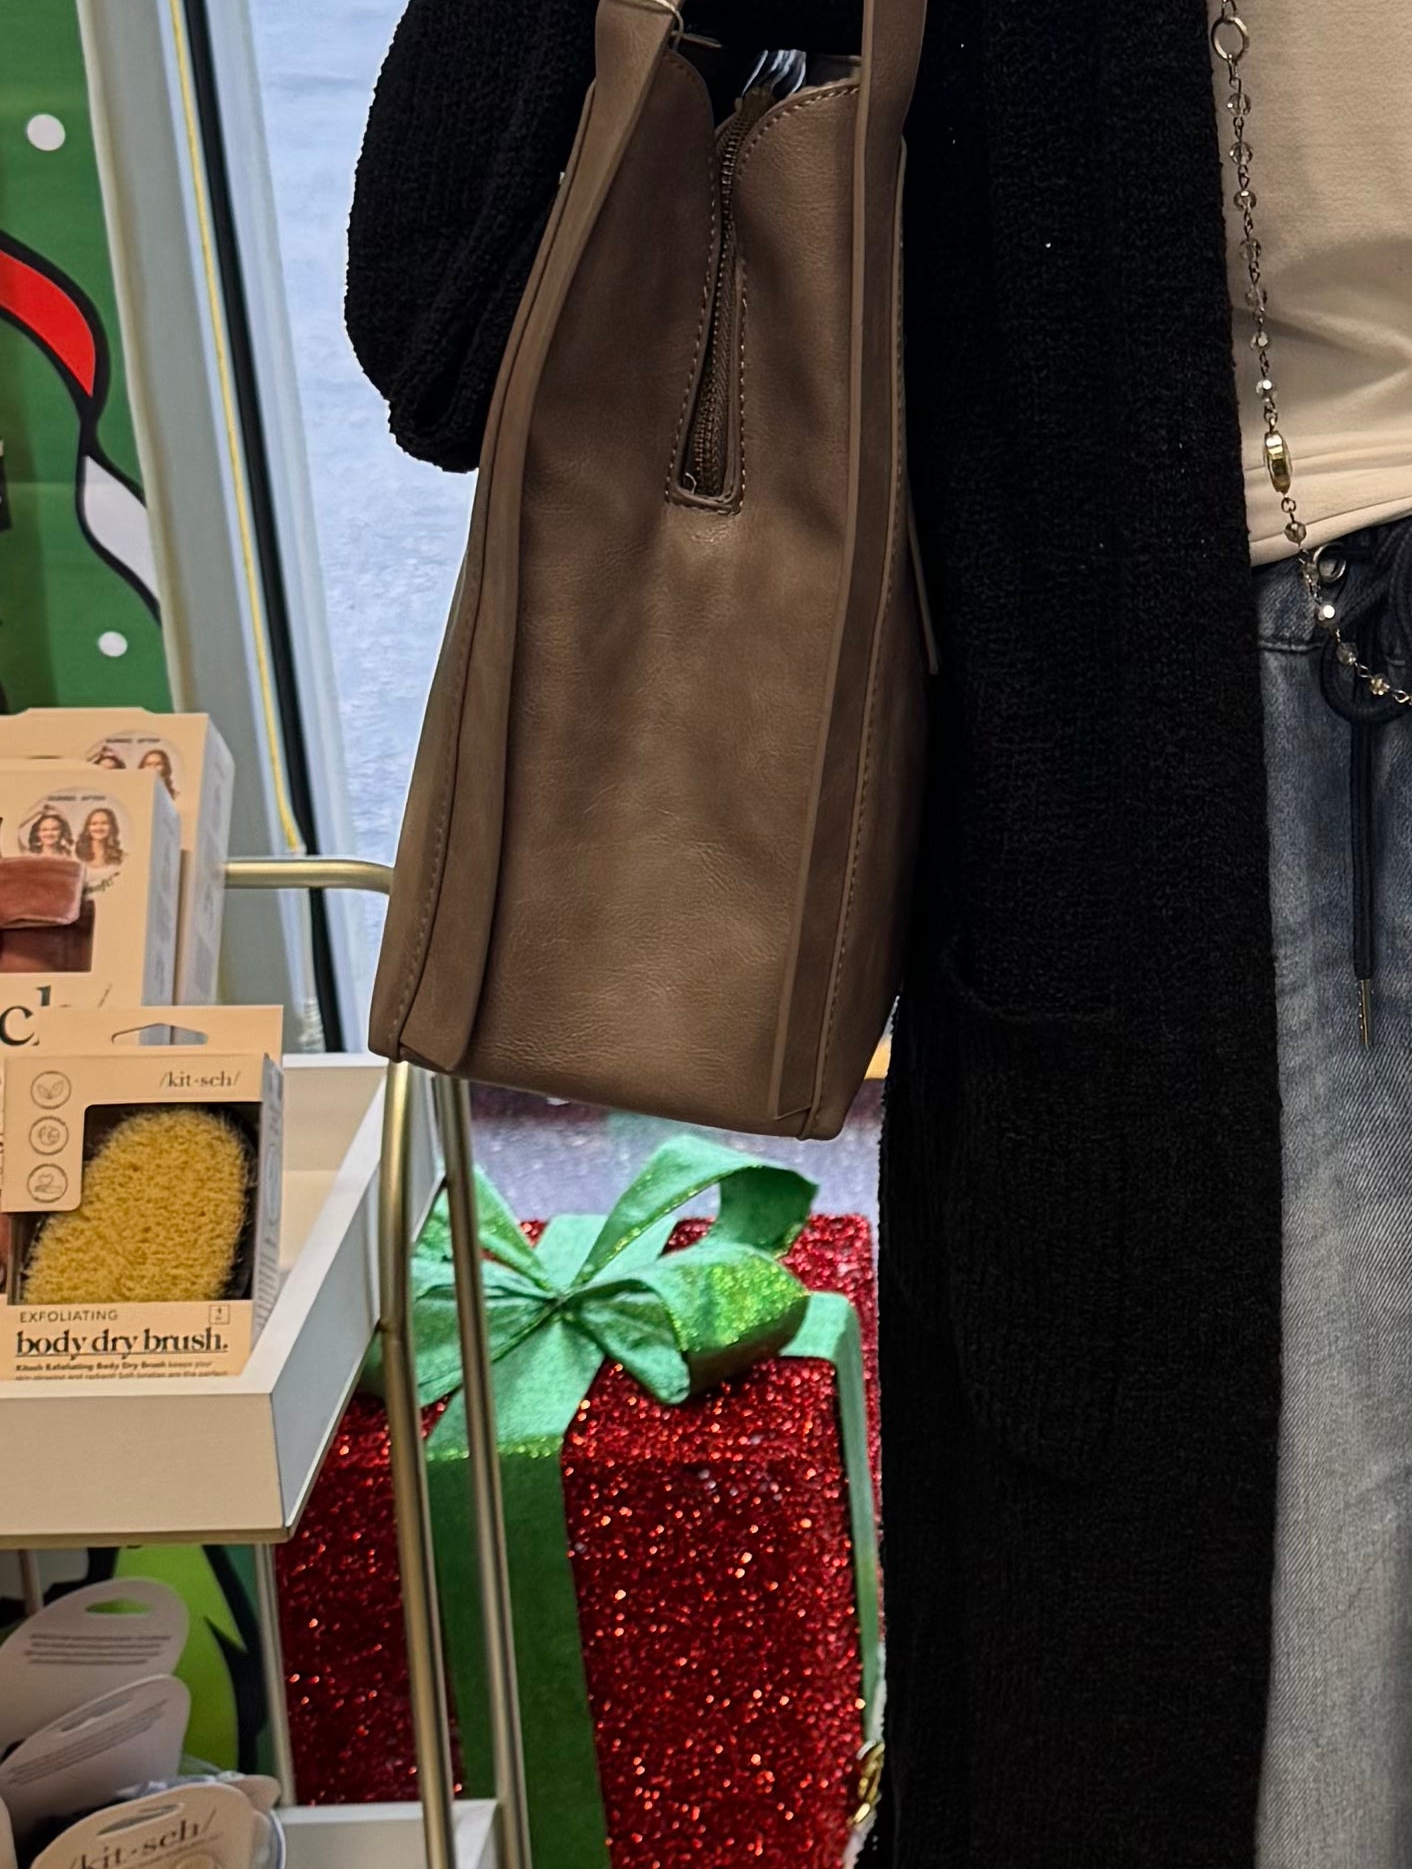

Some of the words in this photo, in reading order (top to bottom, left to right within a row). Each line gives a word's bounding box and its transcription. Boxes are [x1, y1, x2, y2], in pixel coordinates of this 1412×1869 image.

[19, 1309, 119, 1324] EXFOLIATING
[16, 1330, 88, 1361] body
[91, 1328, 138, 1360] dry
[143, 1326, 229, 1353] brush.
